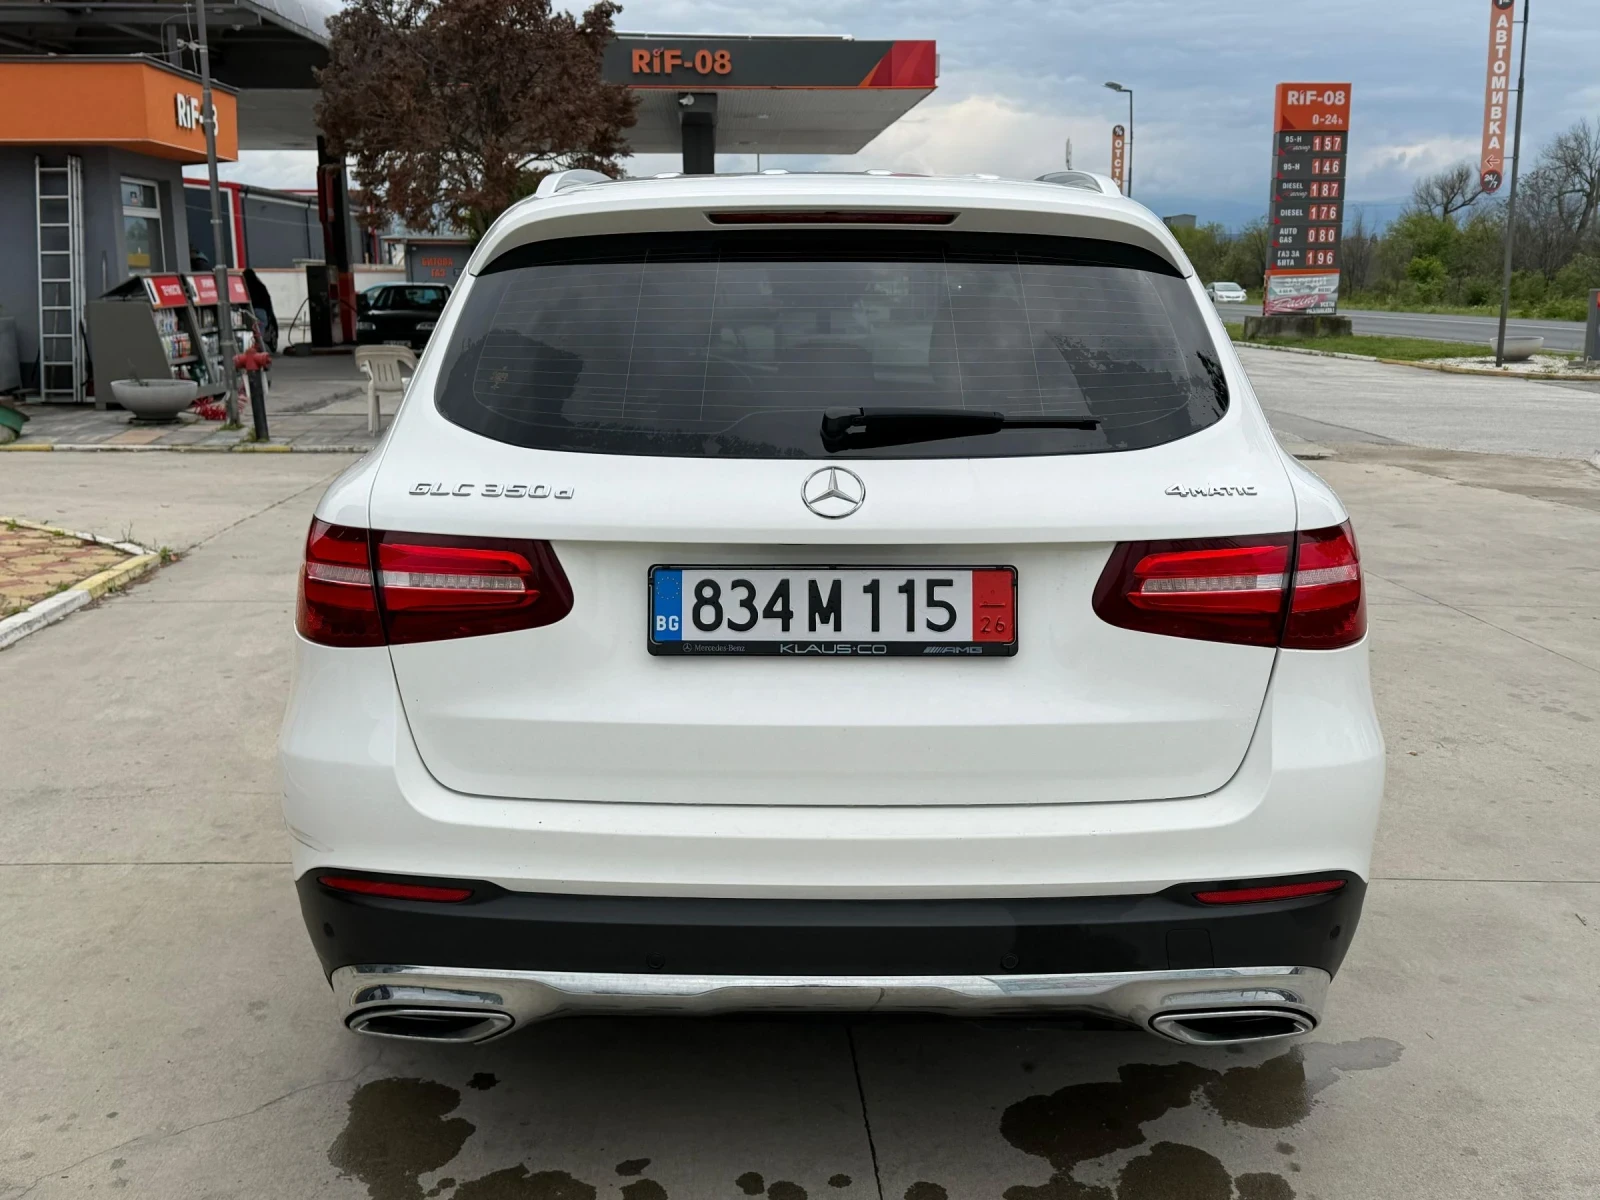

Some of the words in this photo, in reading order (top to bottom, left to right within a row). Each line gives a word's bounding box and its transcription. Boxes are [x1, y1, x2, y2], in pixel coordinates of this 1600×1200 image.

[631, 48, 732, 75] RiF-08
[1488, 14, 1509, 150] АВТОМИВКА
[1287, 90, 1346, 106] RiF-08
[1314, 137, 1341, 150] 157
[1314, 161, 1339, 174] 146
[1312, 184, 1338, 197] 187
[1280, 209, 1303, 217] DIESEL
[1311, 206, 1337, 220] 176
[1279, 227, 1298, 235] AUTO
[1308, 229, 1335, 242] 080
[1279, 236, 1293, 244] GAS
[1277, 250, 1290, 258] ГАЗ
[1307, 251, 1334, 265] 196
[409, 482, 475, 497] GLC
[692, 578, 794, 632] 834
[808, 579, 842, 632] M
[863, 578, 957, 632] 115
[656, 615, 679, 631] BG
[980, 616, 1005, 634] 26
[694, 644, 746, 652] Mercedes-Benz
